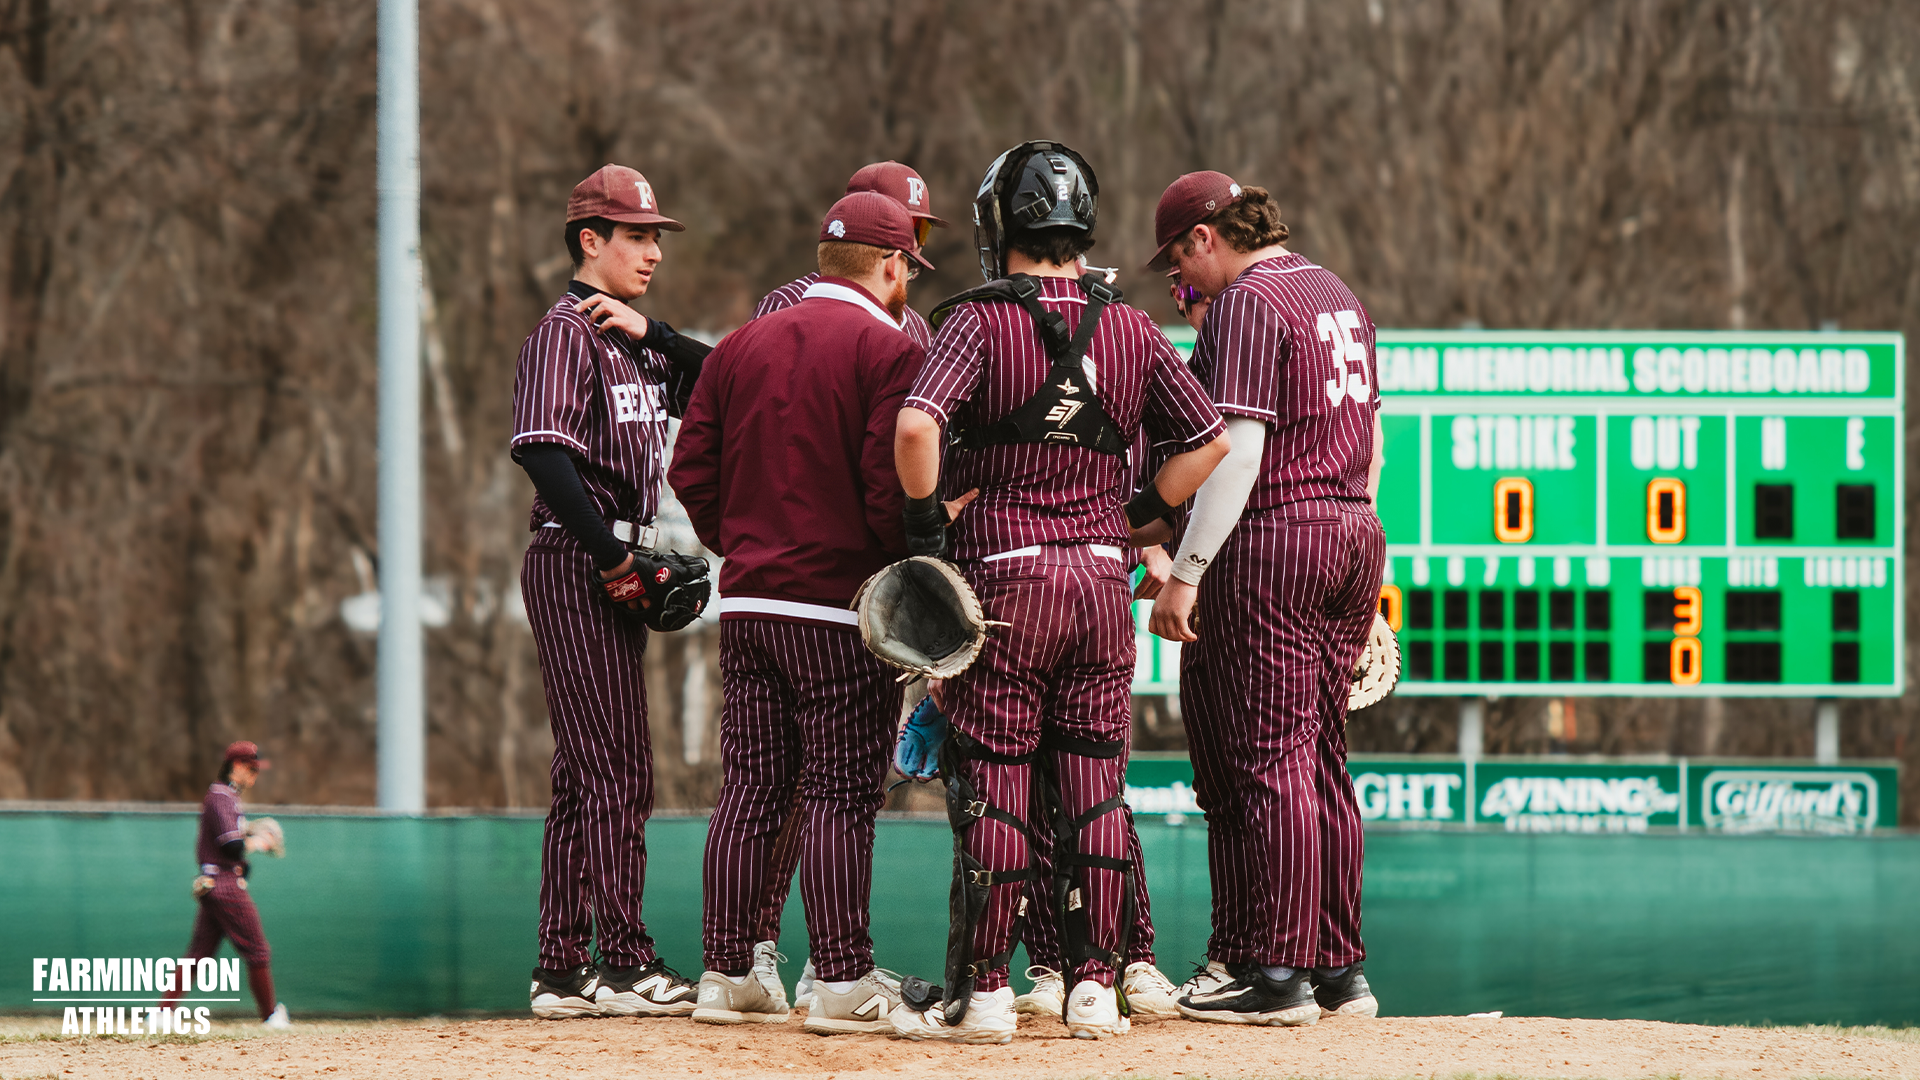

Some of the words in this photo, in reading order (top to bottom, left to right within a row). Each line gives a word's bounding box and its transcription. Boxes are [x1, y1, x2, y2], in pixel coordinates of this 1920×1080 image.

[635, 181, 652, 209] F
[907, 176, 924, 206] F
[1317, 310, 1371, 407] 35
[1443, 346, 1630, 393] MEMORIAL
[1633, 346, 1870, 394] SCOREBOARD
[1451, 415, 1577, 471] STRIKE
[1631, 415, 1702, 471] OUT
[1846, 416, 1866, 471] E
[1493, 477, 1534, 543] 0
[1646, 477, 1687, 543] 0
[1673, 586, 1702, 637] 3
[1670, 635, 1702, 686] 0
